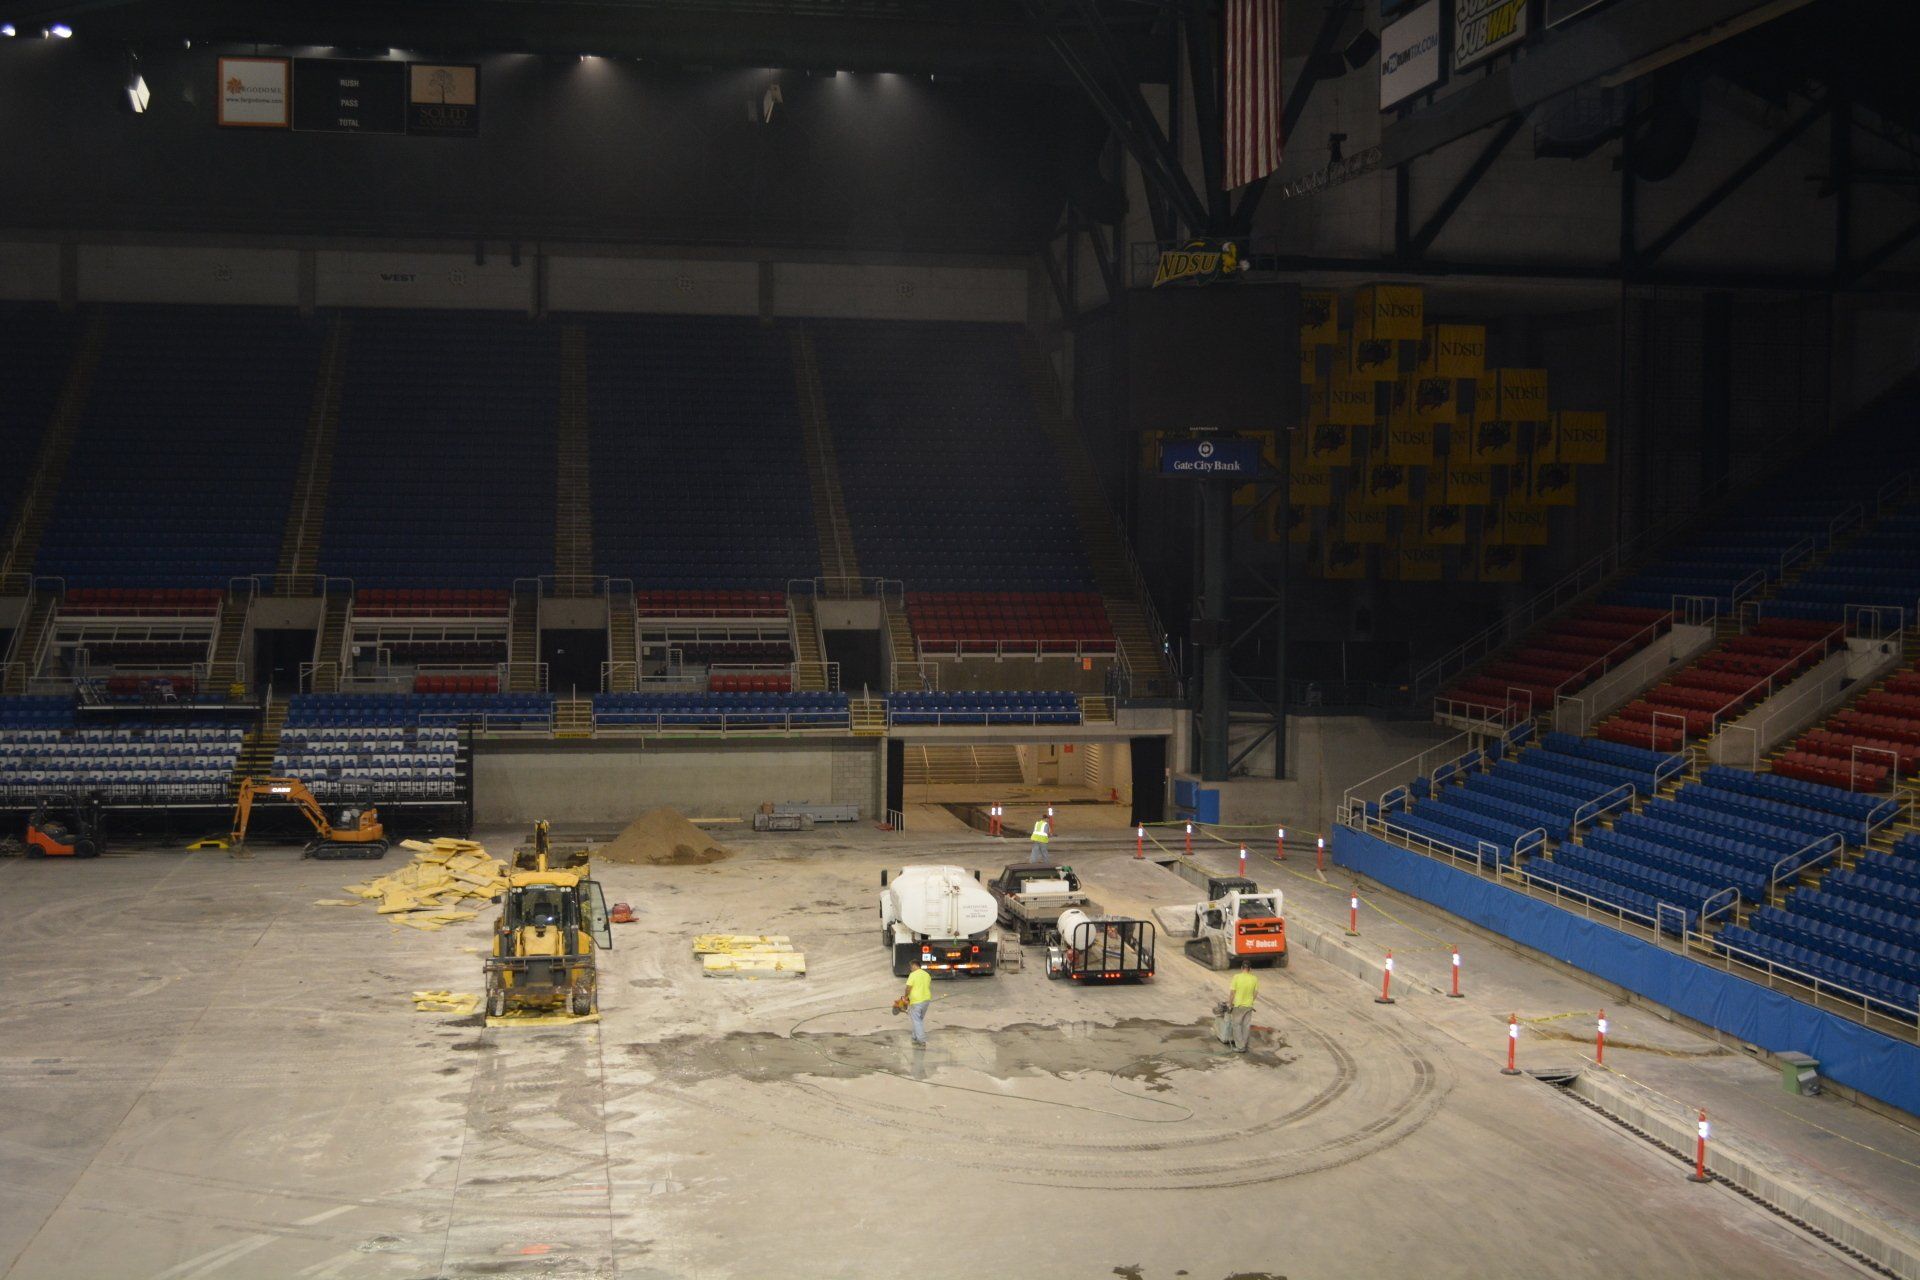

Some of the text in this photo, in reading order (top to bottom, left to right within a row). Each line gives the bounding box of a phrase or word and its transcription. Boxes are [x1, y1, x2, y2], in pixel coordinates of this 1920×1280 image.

[340, 79, 360, 88] RUSH
[340, 98, 359, 107] PASS
[339, 118, 360, 128] TOTAL
[1157, 253, 1217, 281] NDSU
[380, 273, 417, 282] WEST
[1379, 303, 1421, 318] NDSU
[1440, 342, 1484, 357] NDSU
[1332, 390, 1373, 404] NDSU
[1503, 386, 1545, 400] NDSU
[1392, 431, 1431, 445] NDSU
[1563, 428, 1604, 442] NDSU
[1173, 460, 1241, 473] Gate City Bank
[1450, 471, 1490, 484] NDSU
[1256, 940, 1277, 948] Bobcat
